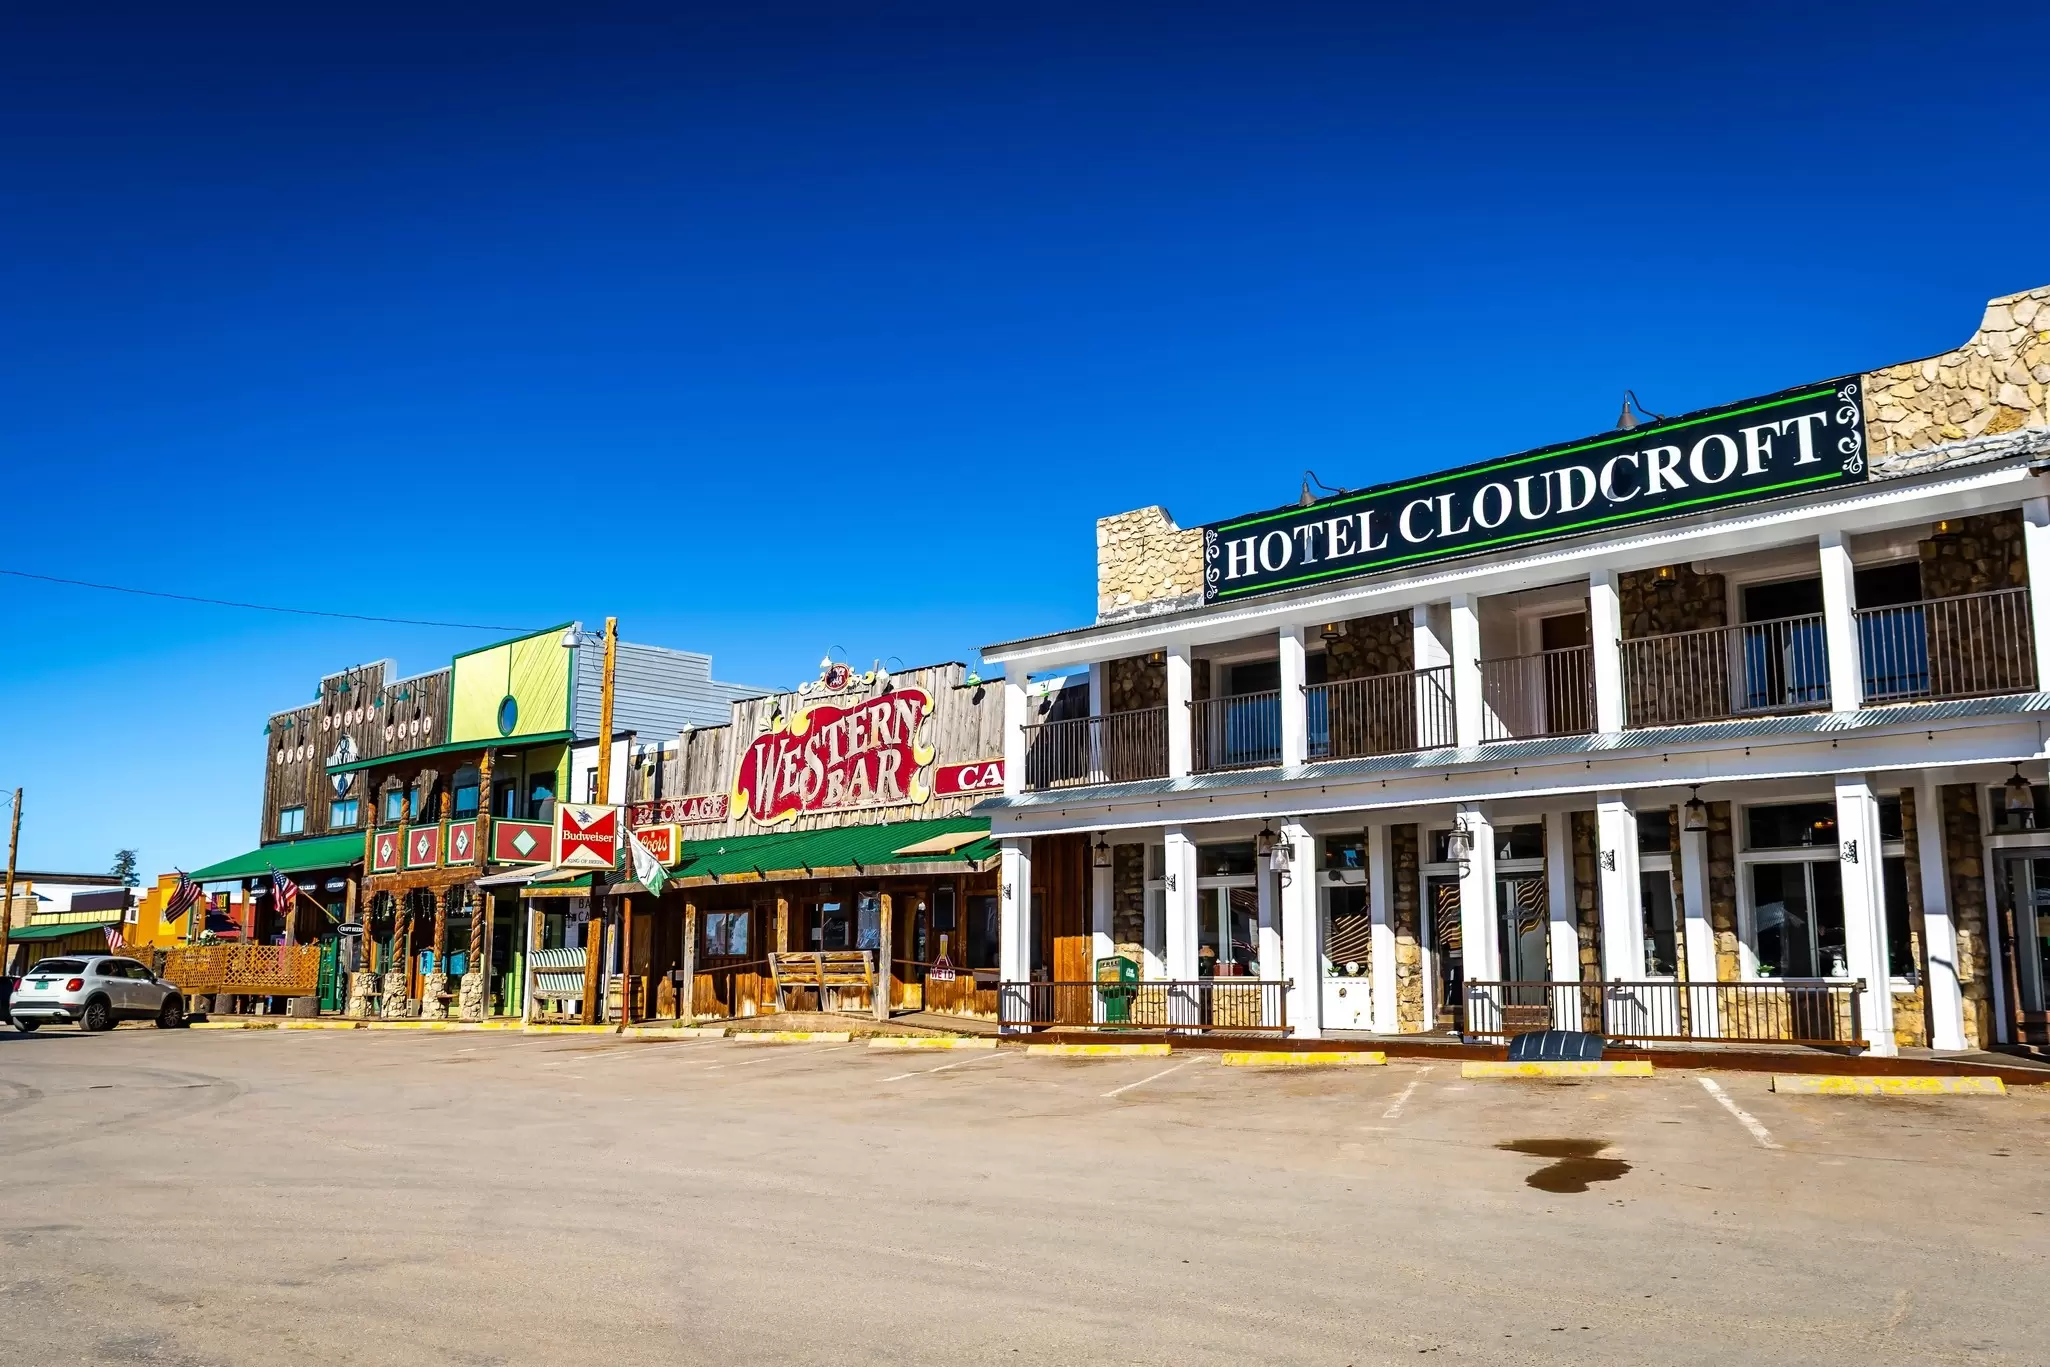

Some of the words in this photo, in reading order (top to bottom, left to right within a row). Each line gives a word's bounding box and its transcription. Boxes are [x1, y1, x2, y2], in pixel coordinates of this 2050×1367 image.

[1223, 511, 1390, 579] HOTEL
[1399, 410, 1828, 542] CLOUDCROFT
[387, 717, 431, 742] MALL
[754, 698, 922, 813] WESTERN
[826, 748, 903, 804] BAR
[957, 763, 1004, 790] CA
[562, 829, 613, 843] Budweiser
[641, 835, 667, 852] Coors
[579, 898, 590, 909] BA
[578, 911, 590, 922] CA
